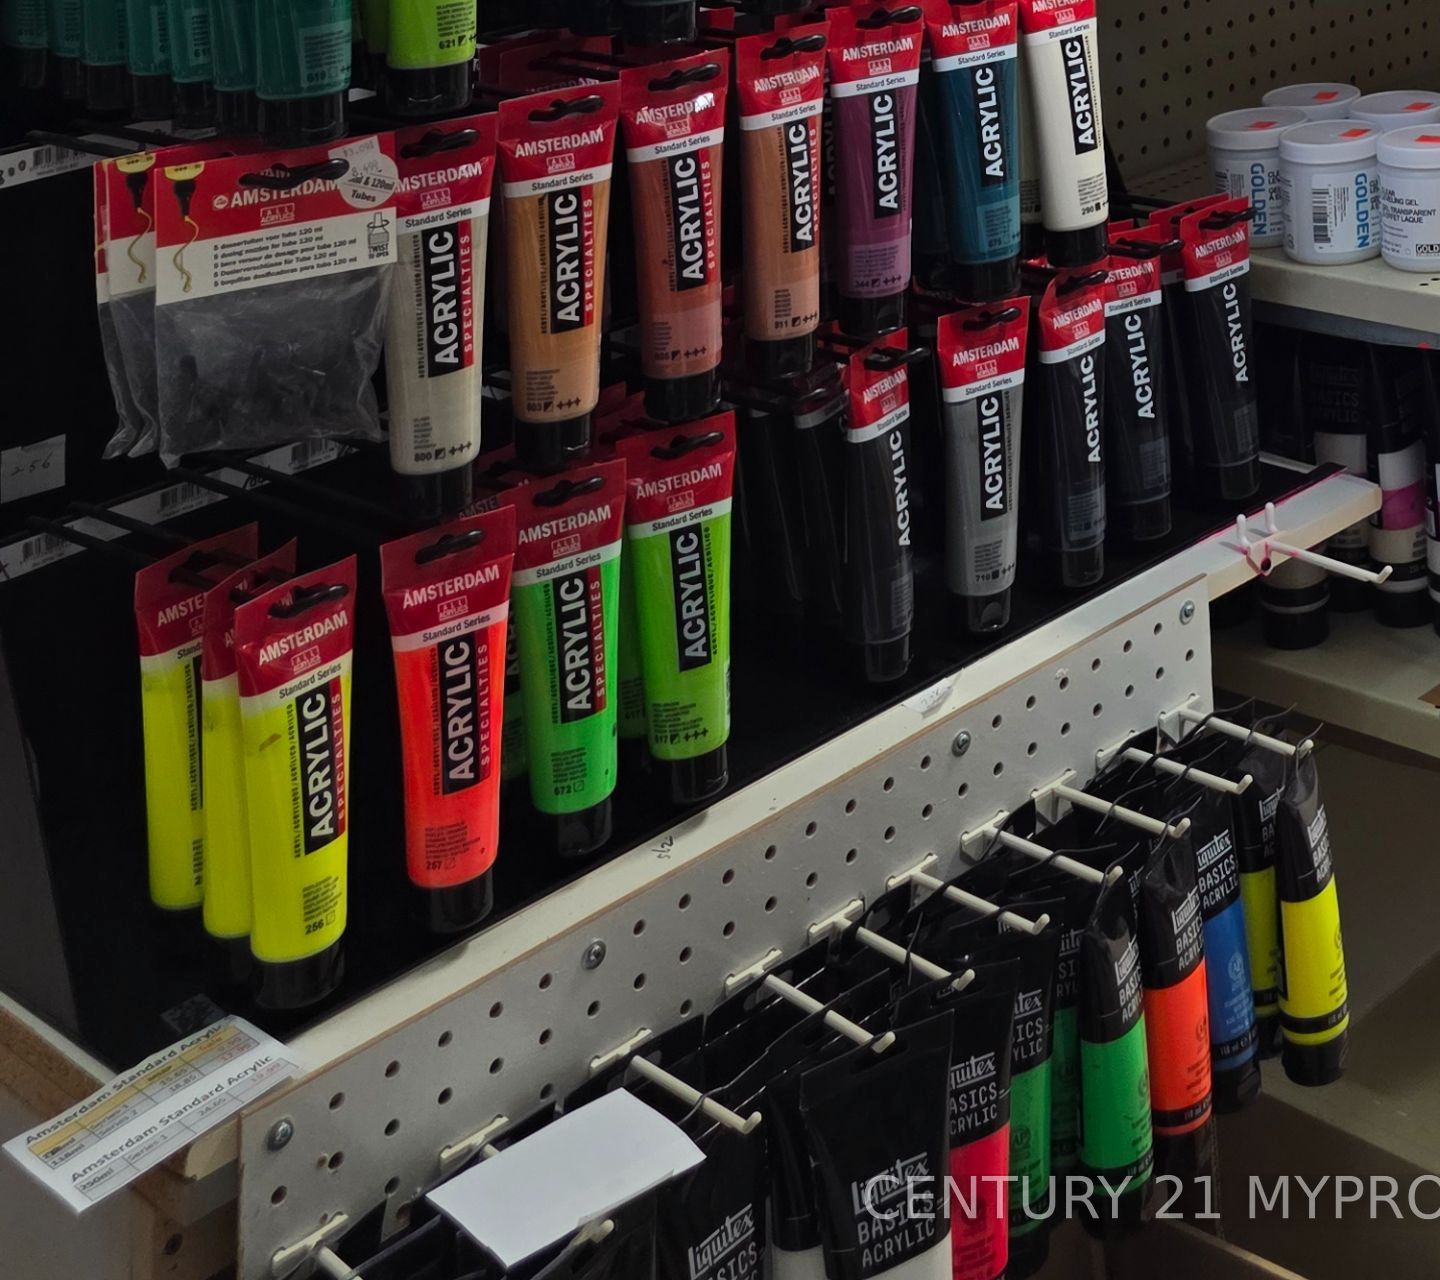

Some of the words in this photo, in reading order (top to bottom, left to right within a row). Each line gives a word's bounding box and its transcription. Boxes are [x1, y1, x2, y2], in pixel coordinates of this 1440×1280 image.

[514, 126, 604, 159] AMSTERDAM
[554, 192, 580, 323] ACRYLIC
[583, 197, 594, 313] SPECIALTIES
[258, 609, 348, 667] AMSTERDAM
[402, 563, 501, 610] AMSTERDAM
[305, 690, 335, 837] ACRYLIC
[444, 640, 475, 782] ACRYLIC
[478, 642, 491, 767] SPECIALTIES
[26, 1088, 111, 1144] Amsterdam
[113, 1048, 177, 1093] Standard
[71, 1124, 158, 1183] Amsterdam
[158, 1083, 225, 1126] Standard
[227, 1054, 273, 1086] Acrylic
